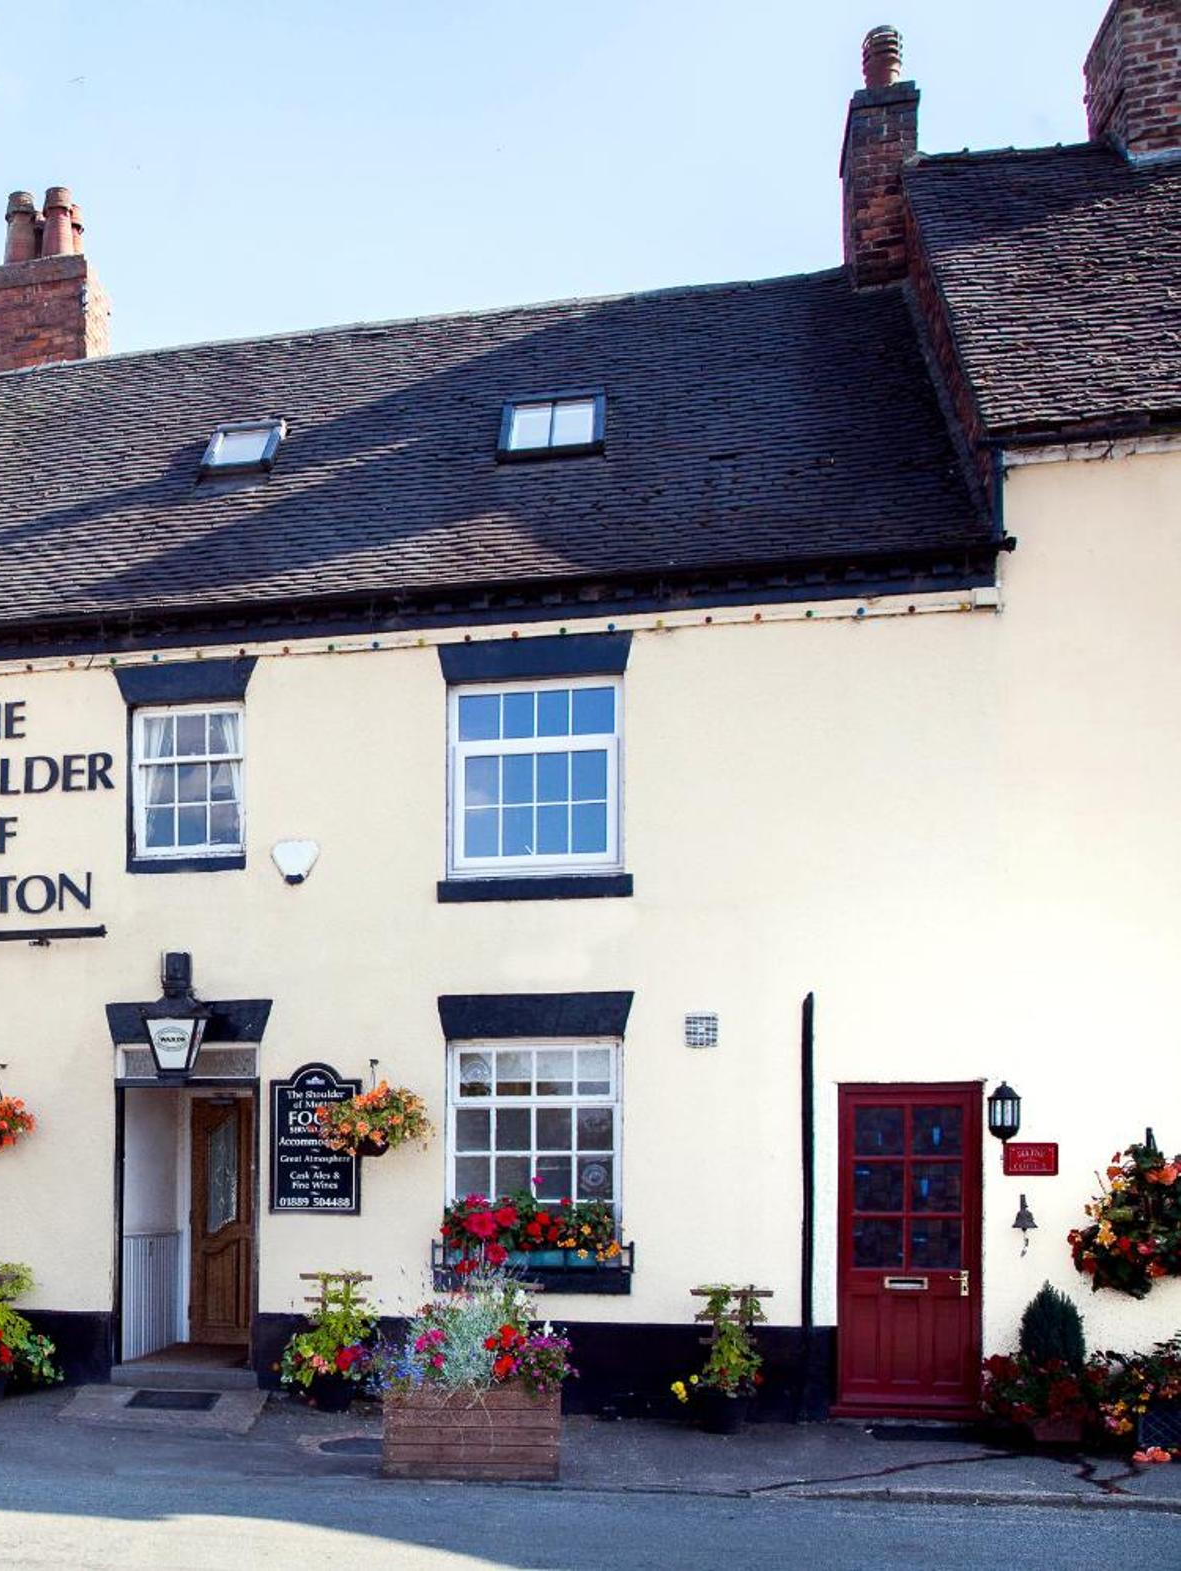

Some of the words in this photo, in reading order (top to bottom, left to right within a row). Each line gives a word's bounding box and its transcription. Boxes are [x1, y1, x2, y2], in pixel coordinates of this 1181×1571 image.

[287, 1090, 304, 1099] The
[305, 1089, 346, 1099] Shoulder
[293, 1100, 302, 1109] of
[280, 1155, 302, 1163] Great
[304, 1154, 351, 1164] Atmosphere
[289, 1171, 310, 1180] Cask
[312, 1171, 331, 1180] Ales
[333, 1171, 340, 1180] &
[292, 1181, 310, 1189] Fine
[312, 1180, 338, 1189] Wines
[279, 1197, 310, 1207] 01889
[312, 1197, 351, 1207] 504488
